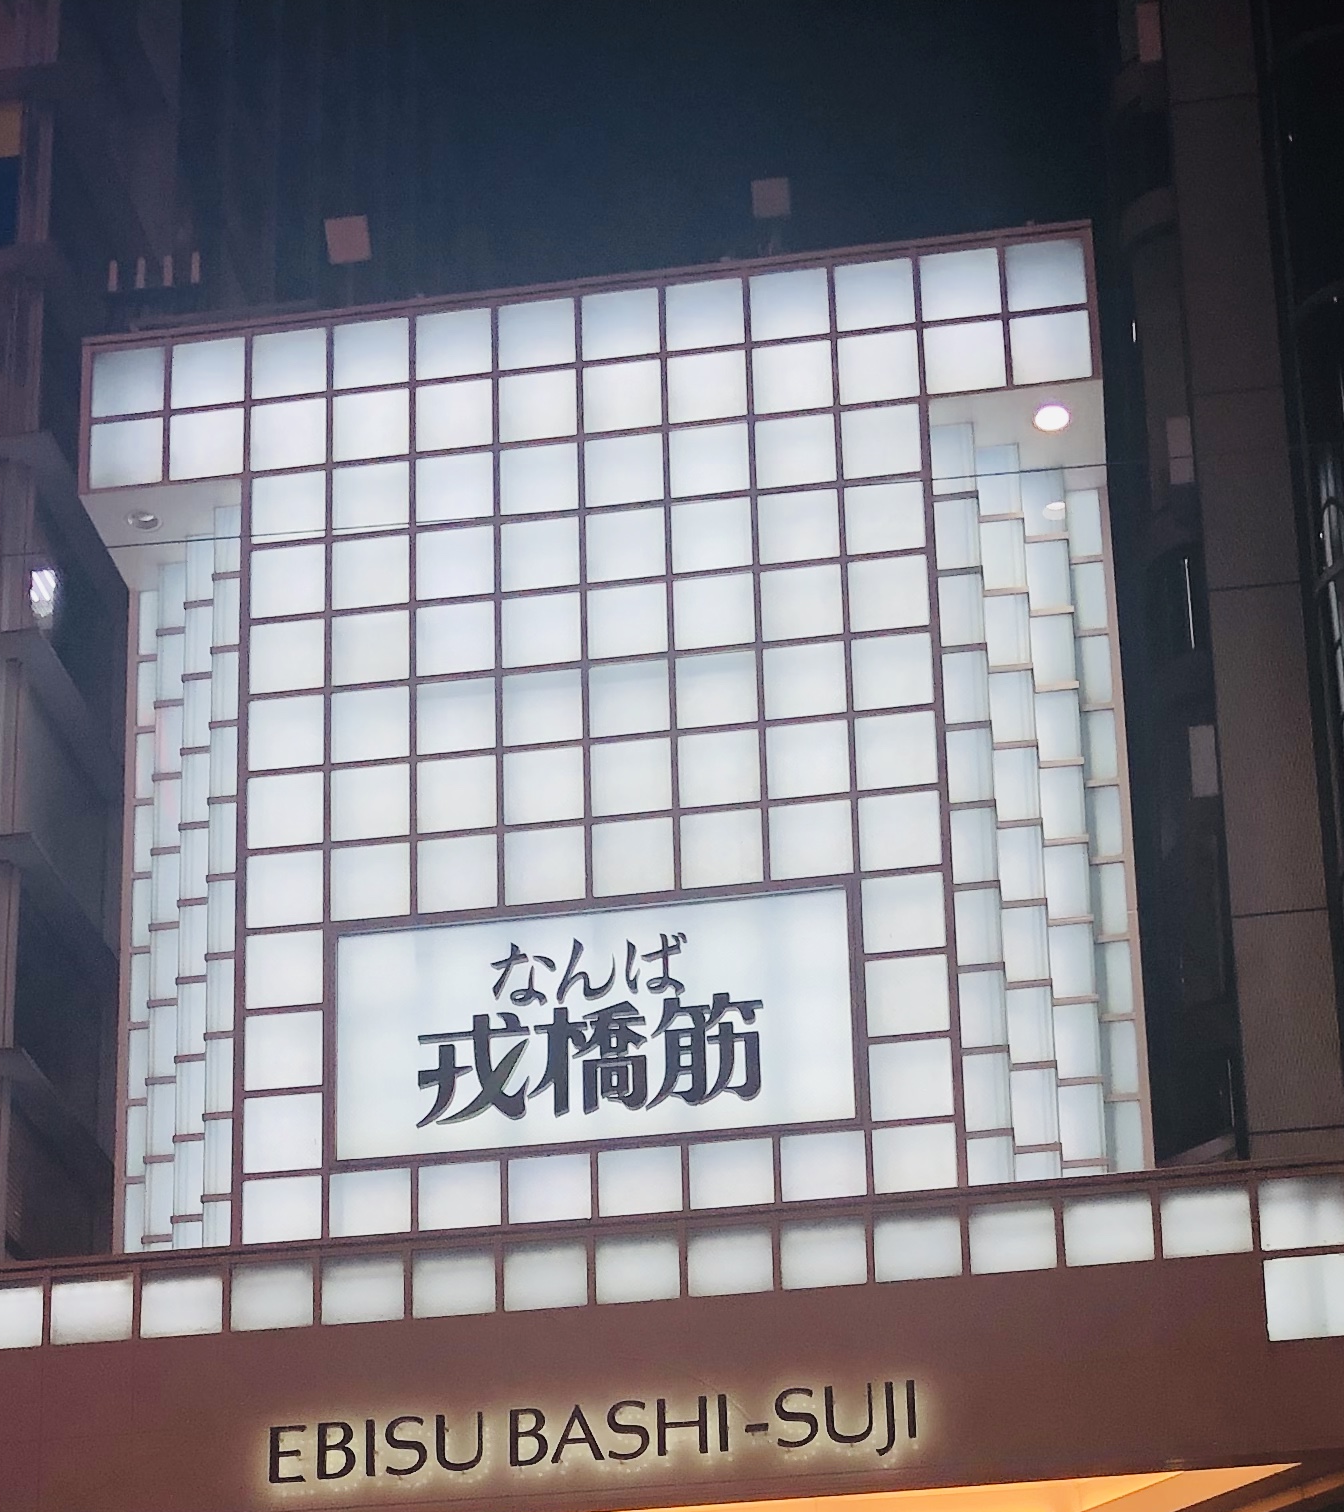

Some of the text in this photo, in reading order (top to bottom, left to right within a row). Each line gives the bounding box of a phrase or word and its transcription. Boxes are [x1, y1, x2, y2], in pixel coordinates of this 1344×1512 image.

[490, 932, 688, 1005] なんば
[415, 992, 764, 1128] 戎橋筋
[267, 1411, 484, 1485] EBISU
